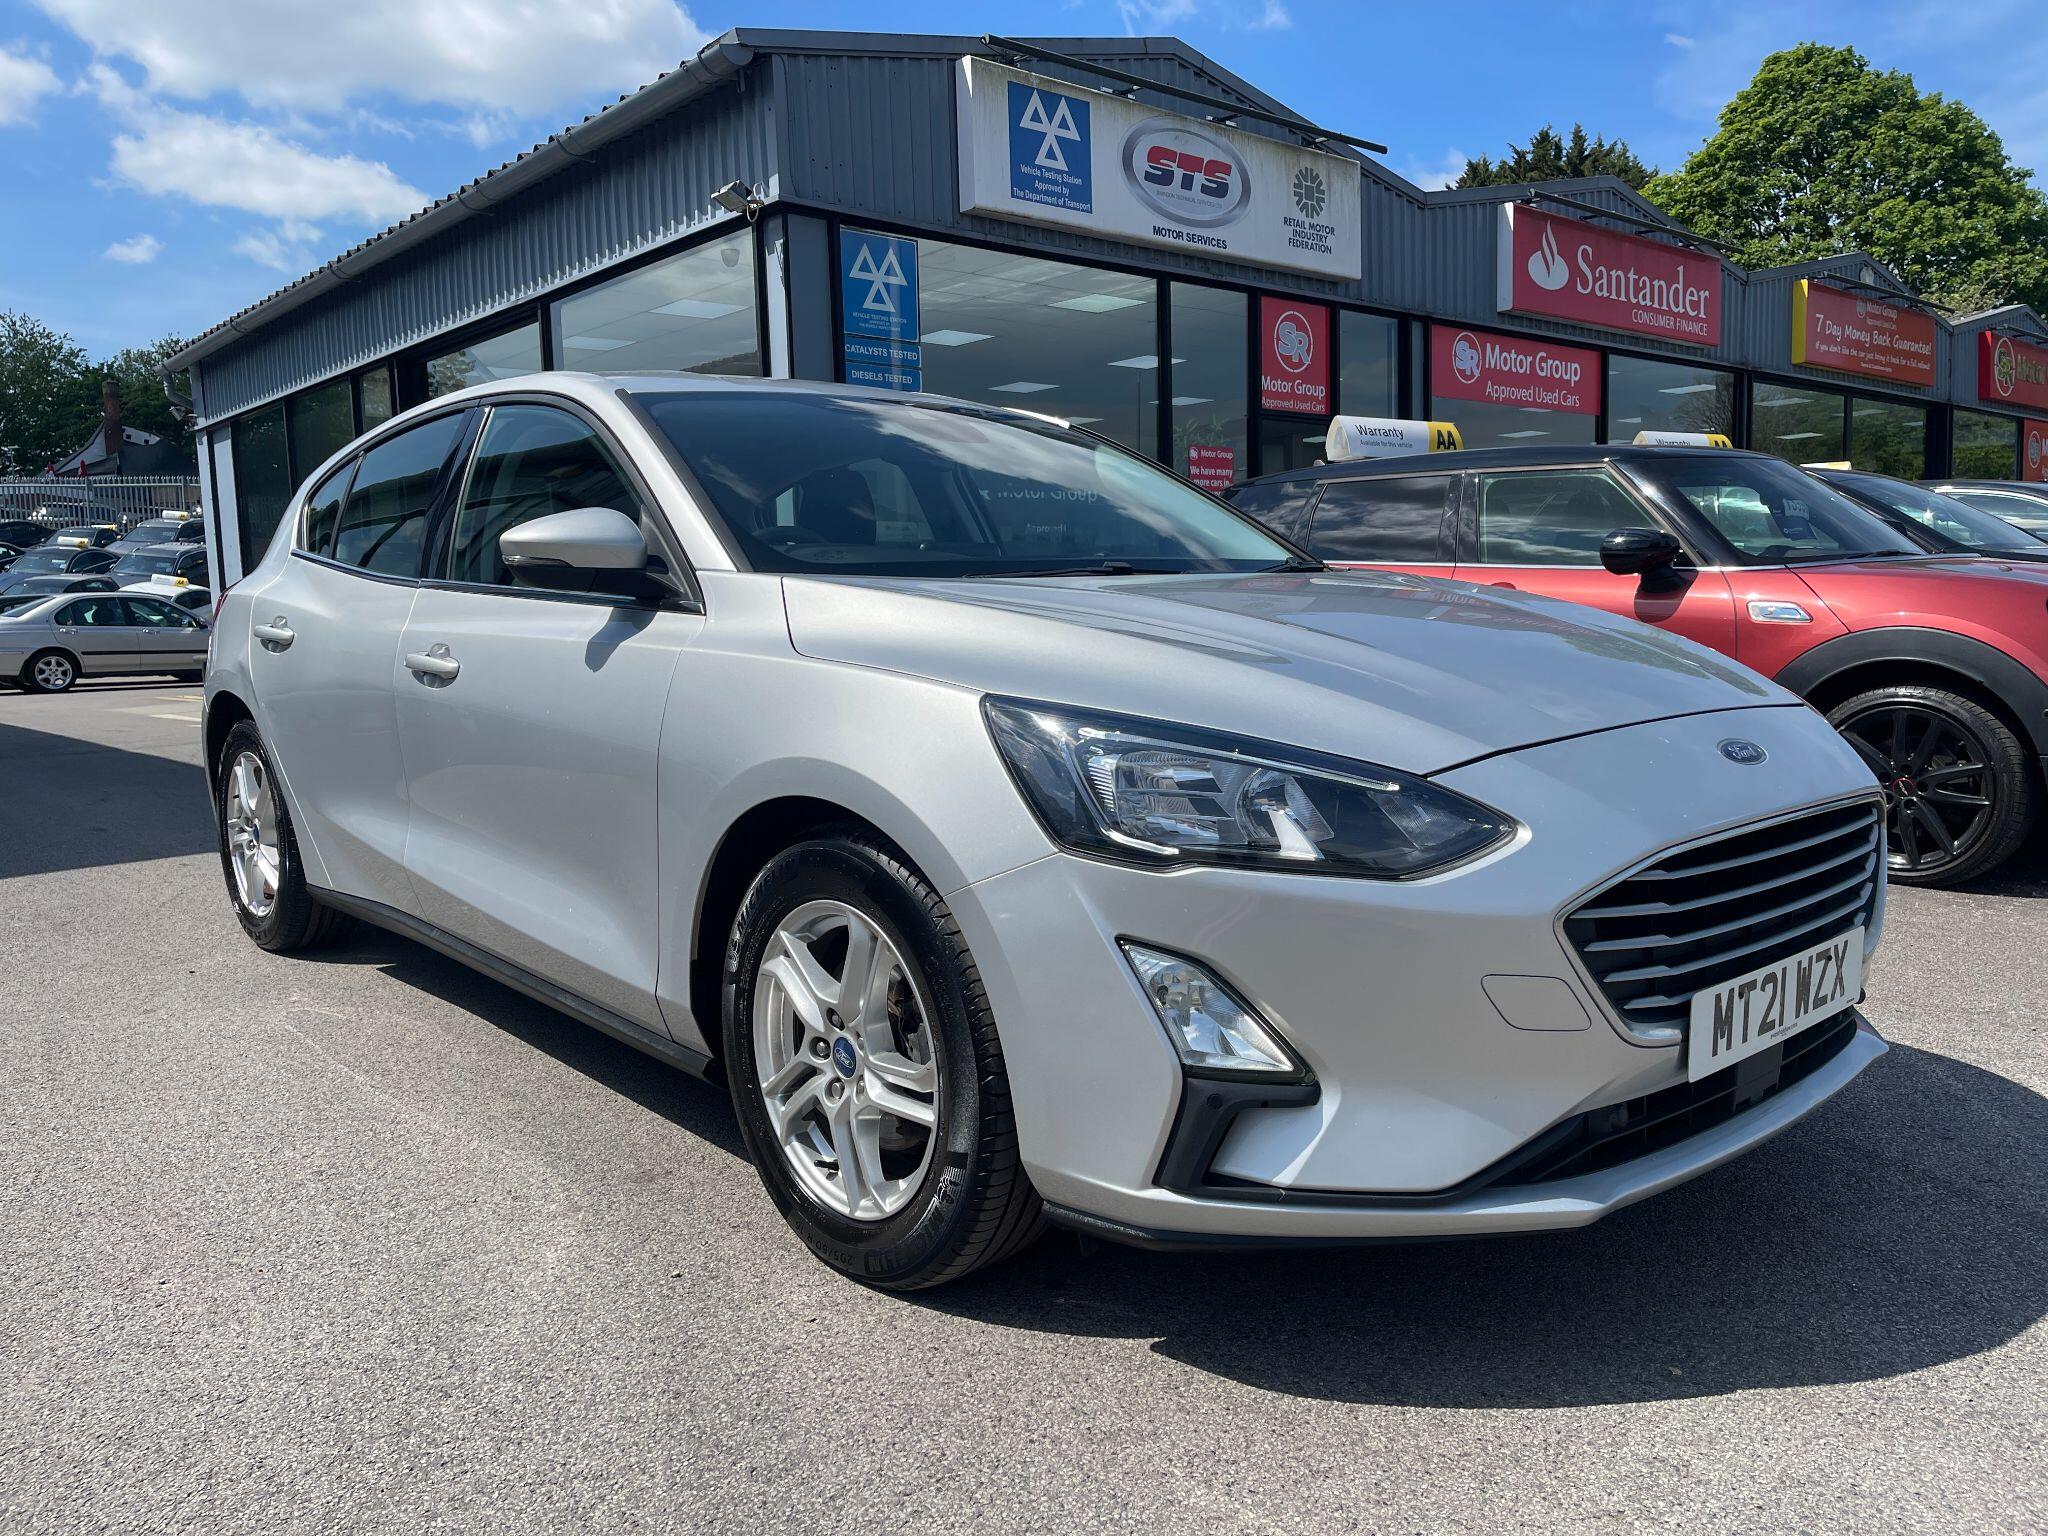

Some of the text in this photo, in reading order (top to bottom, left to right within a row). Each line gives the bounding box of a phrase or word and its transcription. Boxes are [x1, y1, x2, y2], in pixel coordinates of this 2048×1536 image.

[1020, 164, 1082, 185] Vehicle Testing Station
[1144, 146, 1233, 199] STS
[1035, 180, 1070, 196] Approved by
[1013, 187, 1091, 211] The Department of Transport
[1283, 216, 1335, 236] RETAIL MOTOR
[1292, 228, 1328, 244] INDUSTRY
[1153, 225, 1227, 249] MOTOR SERVICES
[1288, 237, 1332, 254] FEDERATION
[1577, 244, 1710, 319] Santander
[1867, 300, 1898, 321] Motor Group
[1632, 309, 1708, 336] CONSUMER FINANCE
[1815, 313, 1932, 355] 7 Day Money Back Guarantee!
[845, 344, 918, 360] CATALYSTS TESTED
[1486, 343, 1581, 387] Motor Group
[851, 370, 913, 384] DIESELS TESTED
[1261, 376, 1326, 400] Motor Group
[1485, 380, 1580, 408] Approved Used Cars
[1261, 396, 1325, 412] Approved Used Cars
[1355, 424, 1457, 451] Warranty AA
[1200, 449, 1233, 460] Motor Group
[1190, 465, 1233, 479] We have many
[1210, 479, 1223, 487] cars
[1711, 939, 1849, 1058] MT21 WZX
